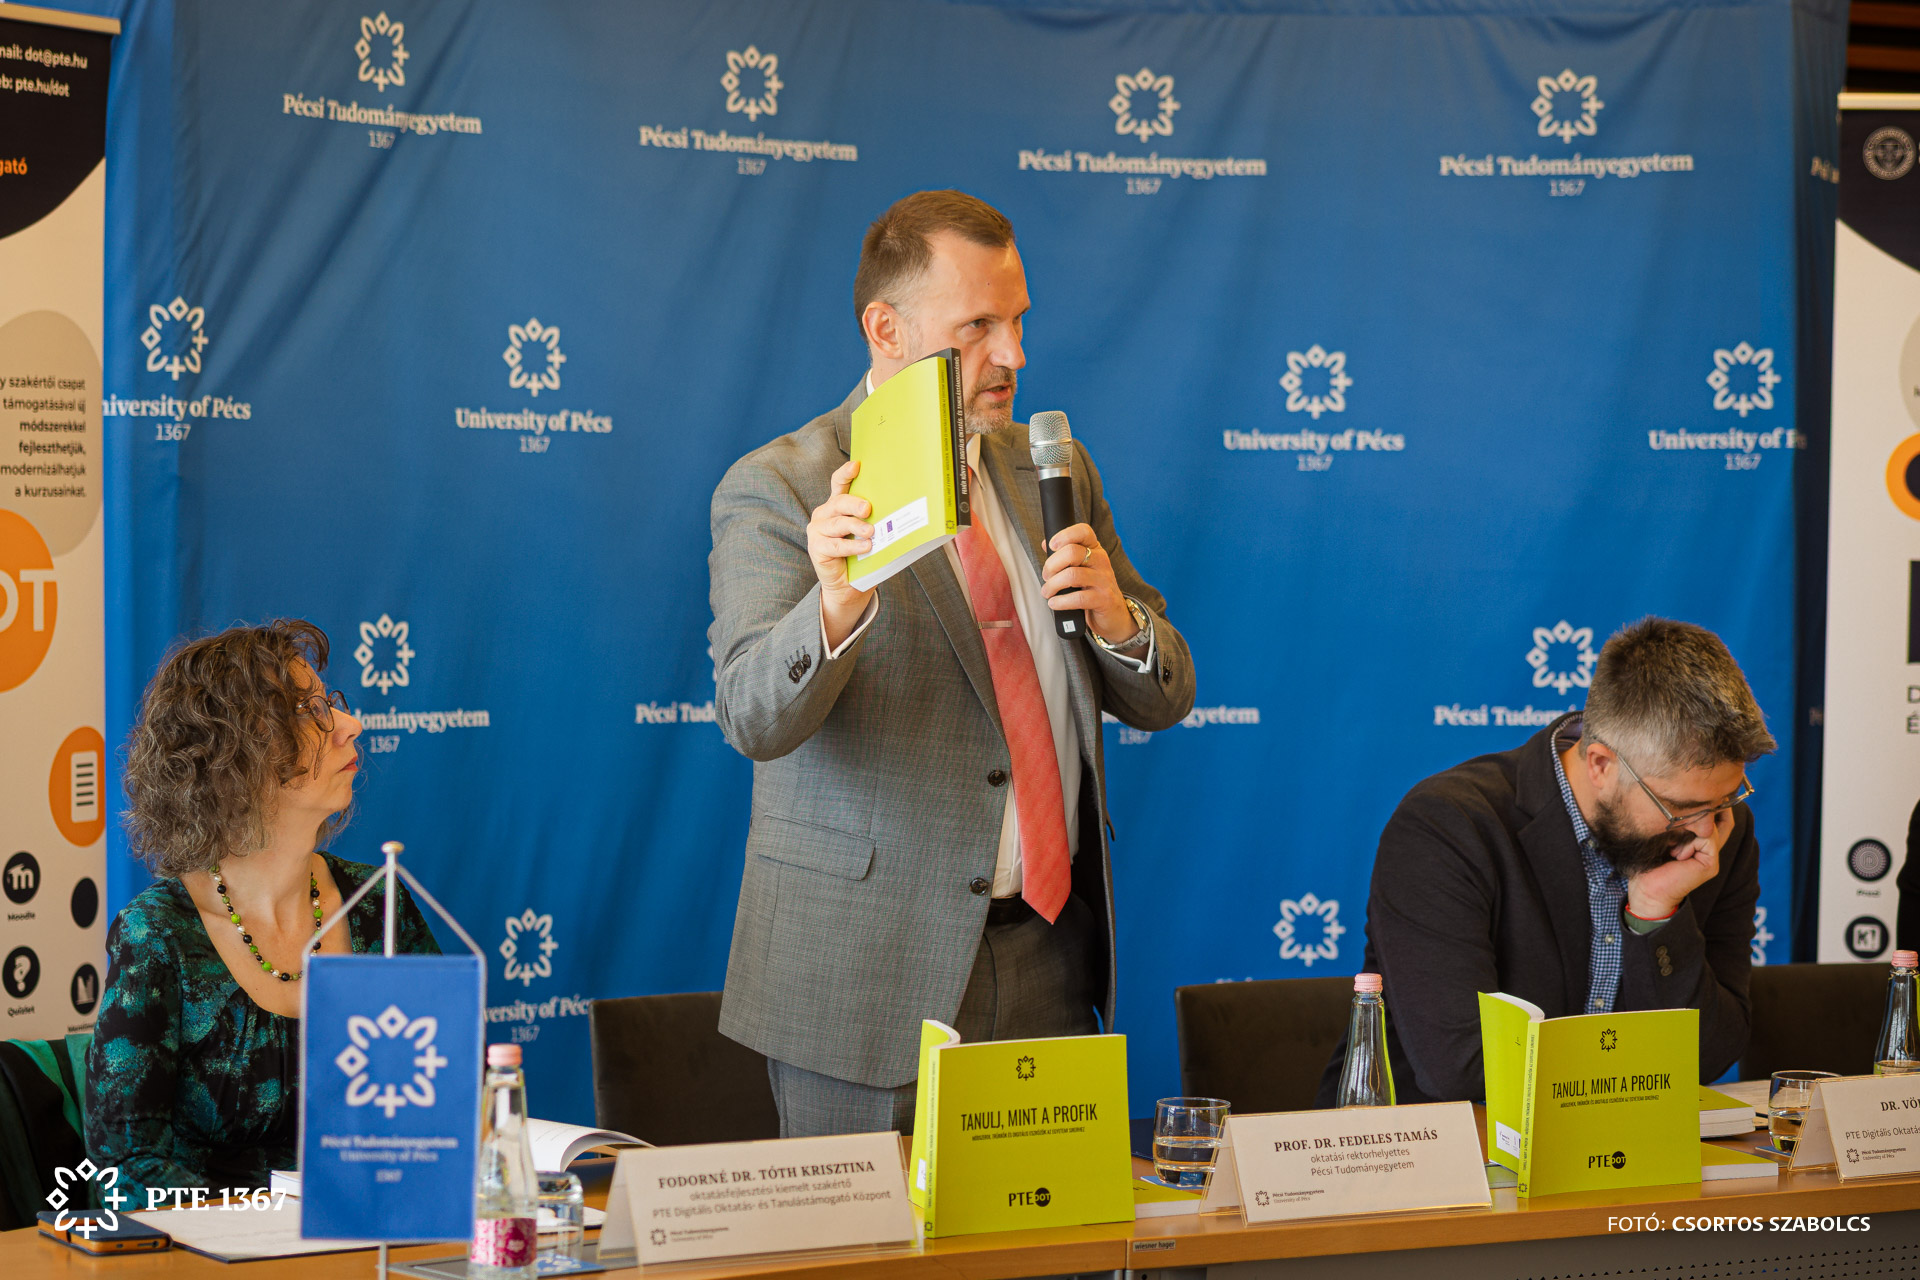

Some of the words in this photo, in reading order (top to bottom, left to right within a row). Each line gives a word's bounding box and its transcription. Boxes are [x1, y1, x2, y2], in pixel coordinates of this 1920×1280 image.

[25, 46, 87, 69] dot@pte.hu
[15, 77, 70, 97] pte.hu/dot
[282, 93, 324, 118] Pécsi
[327, 102, 483, 135] Tudományegyetem
[368, 131, 396, 149] 1367
[639, 124, 688, 149] Pécsi
[691, 130, 858, 162] Tudományegyetem
[1018, 149, 1072, 171] Pécsi
[1075, 152, 1267, 180] Tudományegyetem
[1440, 154, 1494, 176] Pécsi
[1497, 153, 1694, 179] Tudományegyetem
[1126, 178, 1162, 195] 1367
[1549, 180, 1586, 196] 1367
[102, 393, 188, 421] niversity
[189, 395, 211, 417] of
[212, 396, 251, 420] Pécs
[155, 423, 191, 441] 1367
[455, 407, 547, 435] University
[548, 409, 570, 431] of
[571, 409, 613, 433] Pécs
[519, 435, 551, 453] 1367
[1223, 428, 1329, 454] University
[1330, 428, 1355, 451] of
[1356, 428, 1405, 451] Pécs
[1648, 427, 1759, 453] University
[1759, 427, 1784, 449] of
[1724, 453, 1762, 470] 1367
[15, 486, 21, 497] a
[635, 701, 678, 724] Pécsi
[1434, 703, 1489, 726] Pécsi
[370, 735, 400, 753] 1367
[538, 996, 559, 1018] of
[1552, 1081, 1588, 1099] TANULJ,
[1591, 1077, 1617, 1094] MINT
[1620, 1077, 1628, 1092] A
[1631, 1073, 1671, 1091] PROFIK
[961, 1110, 1004, 1131] TANULJ,
[1008, 1108, 1038, 1126] MINT
[1041, 1107, 1050, 1124] A
[1054, 1103, 1098, 1122] PROFIK
[1880, 1101, 1900, 1111] DR.
[1274, 1139, 1311, 1152] PROF.
[1314, 1137, 1336, 1149] DR.
[1339, 1132, 1393, 1147] FEDELES
[1394, 1127, 1438, 1143] TAMÁS
[1846, 1131, 1861, 1140] PTE
[1862, 1128, 1892, 1140] Digitális
[1310, 1152, 1345, 1164] oktatási
[1347, 1147, 1410, 1161] rektorhelyettes
[1589, 1155, 1610, 1168] PTE
[658, 1170, 728, 1189] FODORNÉ
[732, 1171, 756, 1182] DR.
[758, 1165, 797, 1180] TÓTH
[801, 1161, 875, 1177] KRISZTINA
[1310, 1166, 1333, 1176] Pécsi
[1335, 1160, 1415, 1175] Tudományegyetem
[775, 1182, 809, 1194] kiemelt
[813, 1178, 852, 1191] szakértő
[653, 1208, 671, 1218] PTE
[674, 1204, 713, 1218] Digitális
[758, 1200, 769, 1210] és
[771, 1192, 851, 1209] Tanulástámogató
[853, 1189, 891, 1203] Központ
[1009, 1192, 1034, 1207] PTE
